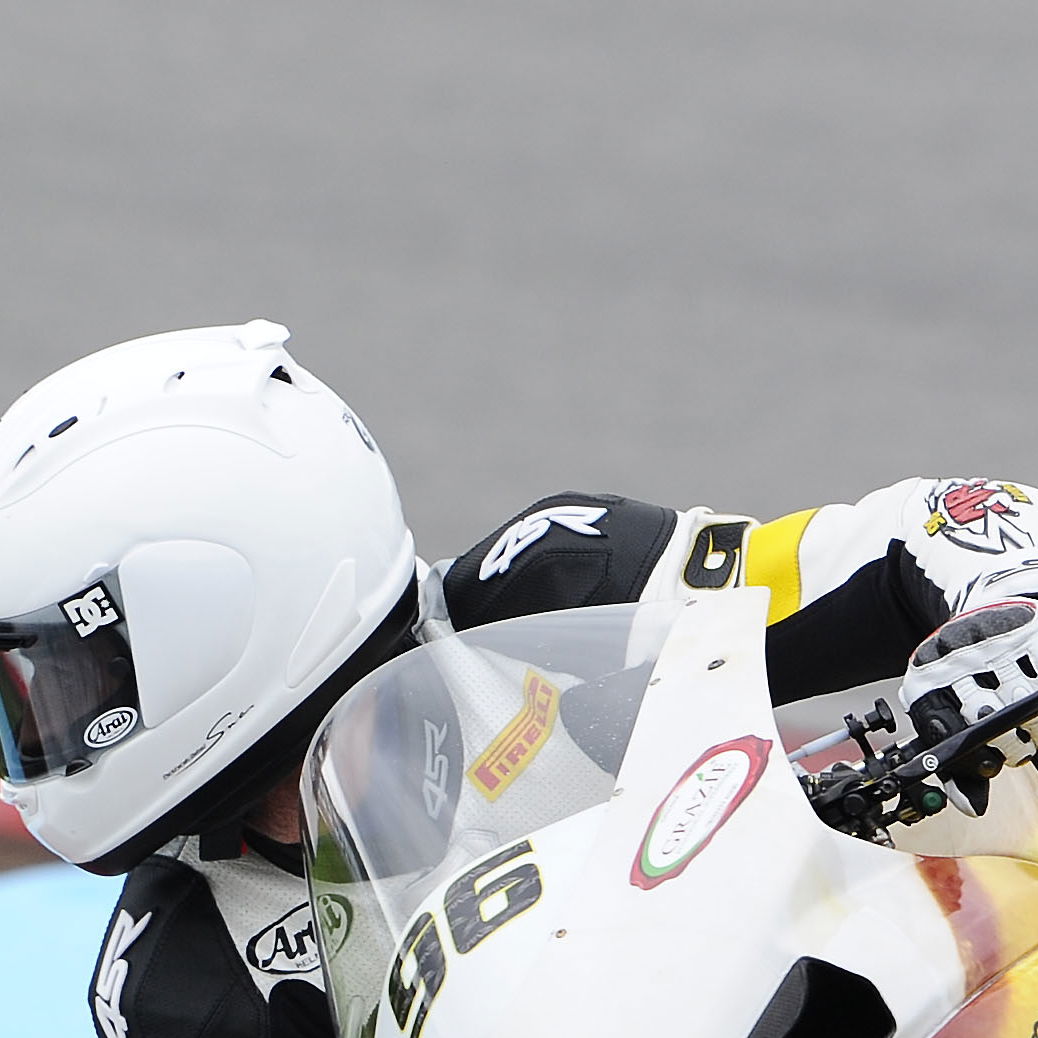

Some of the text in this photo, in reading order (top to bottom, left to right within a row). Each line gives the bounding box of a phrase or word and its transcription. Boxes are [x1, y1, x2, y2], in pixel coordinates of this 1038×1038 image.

[94, 711, 128, 742] Arai
[423, 719, 449, 821] 4SR
[474, 676, 553, 791] PIRELLI
